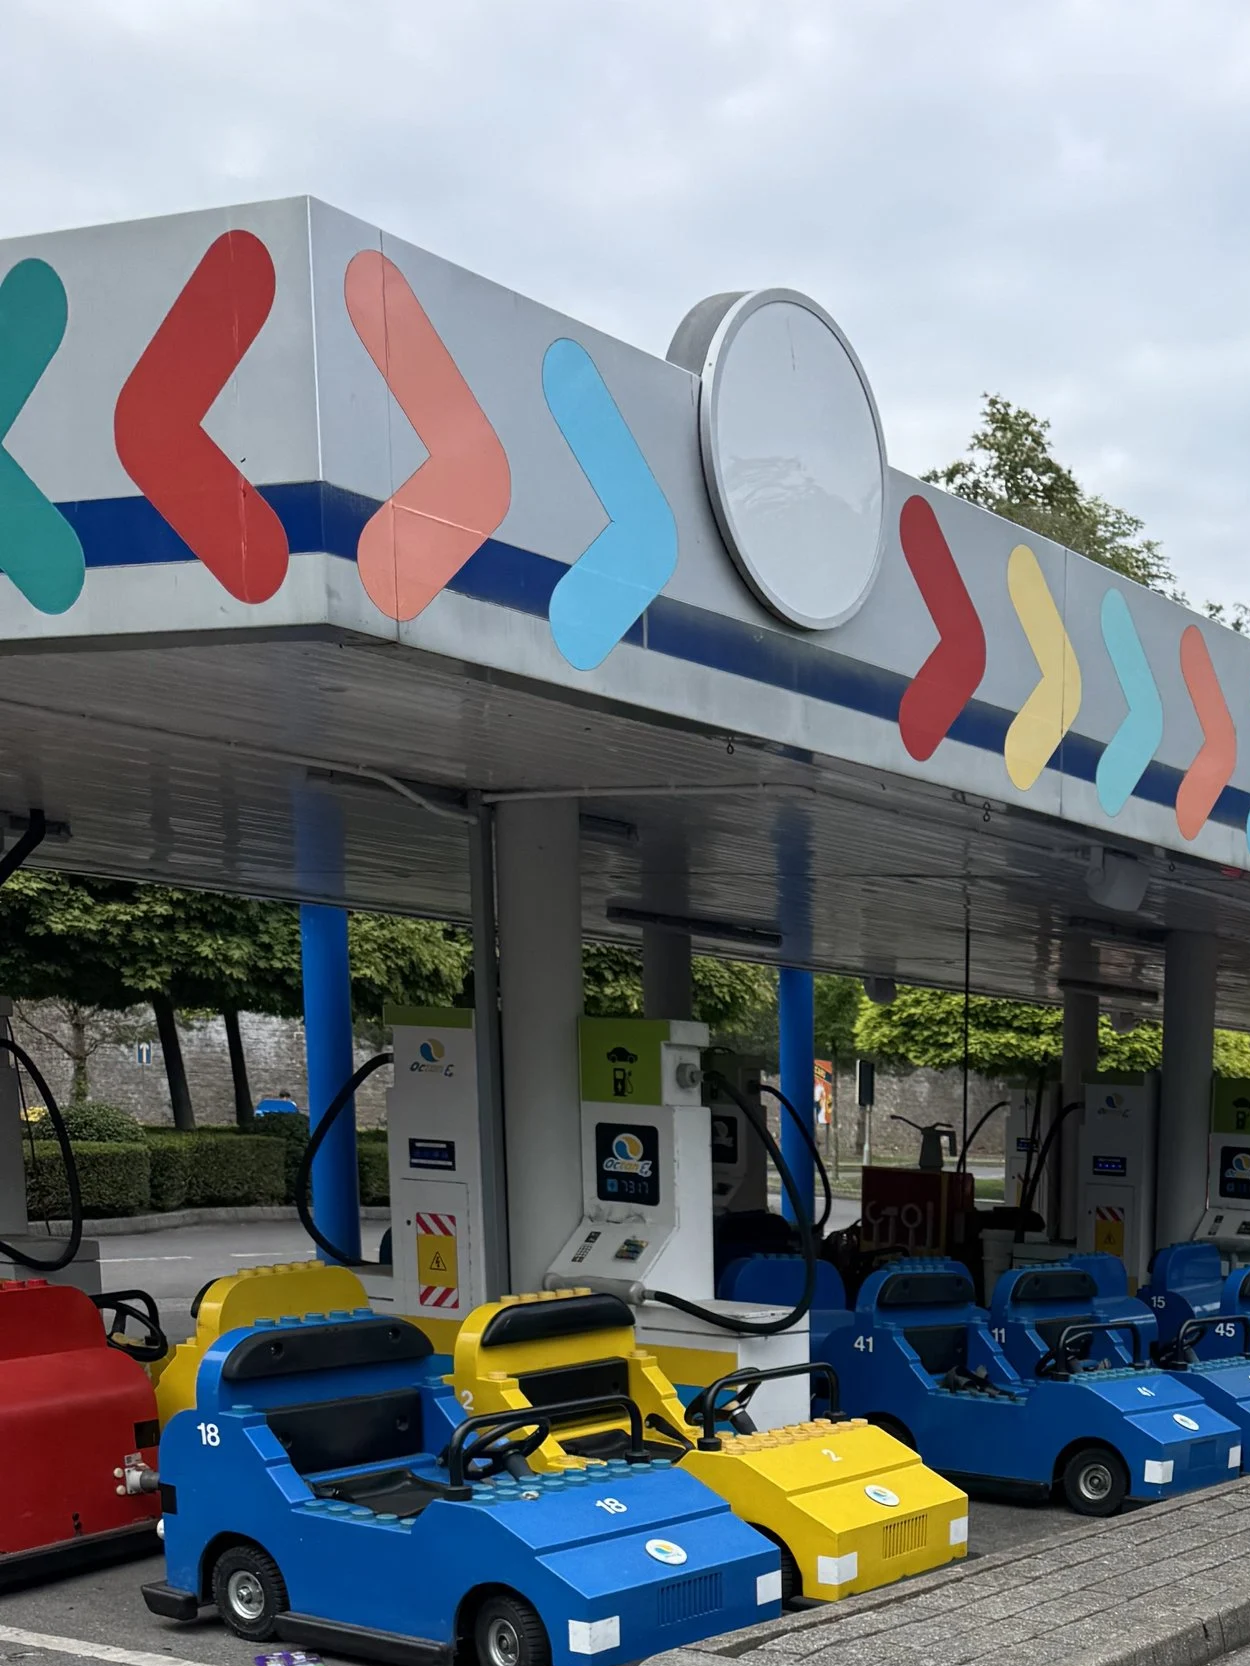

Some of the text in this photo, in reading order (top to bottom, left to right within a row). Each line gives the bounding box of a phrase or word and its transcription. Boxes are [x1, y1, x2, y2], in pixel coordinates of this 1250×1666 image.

[1151, 1295, 1166, 1309] 15
[992, 1327, 1006, 1343] 11
[1214, 1322, 1236, 1337] 45
[853, 1335, 874, 1352] 41
[461, 1389, 474, 1411] 2
[196, 1422, 221, 1447] 18
[821, 1448, 843, 1462] 2
[595, 1497, 628, 1515] 18
